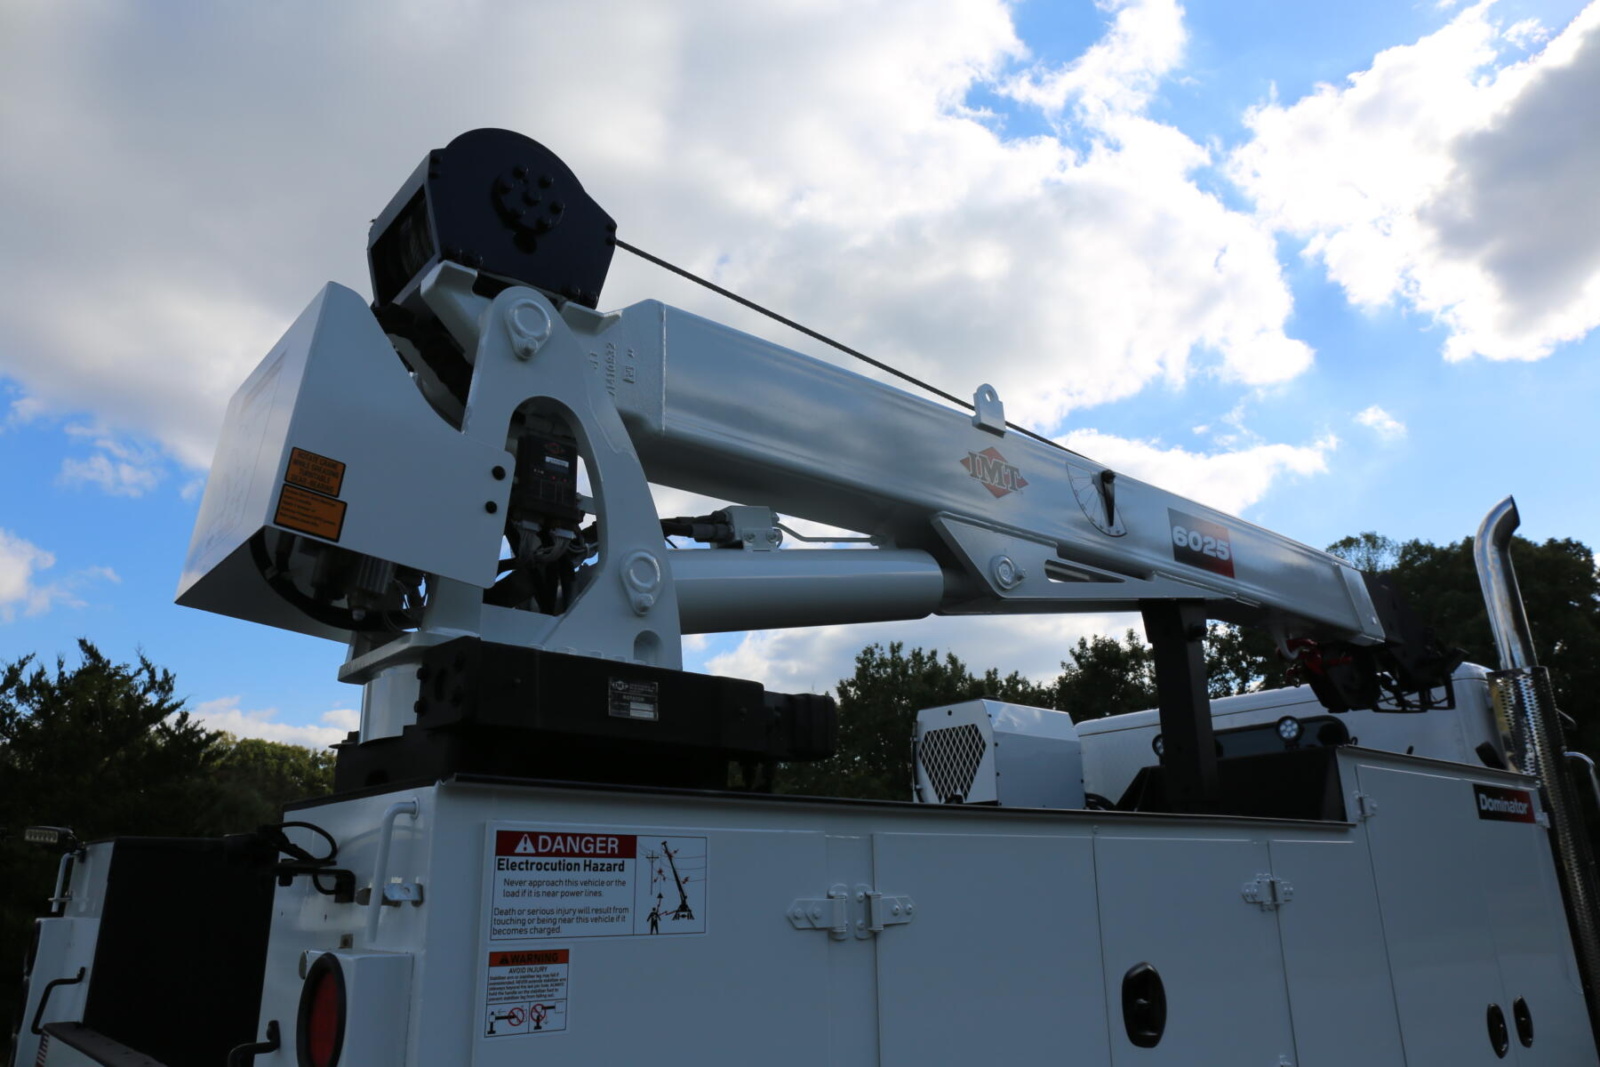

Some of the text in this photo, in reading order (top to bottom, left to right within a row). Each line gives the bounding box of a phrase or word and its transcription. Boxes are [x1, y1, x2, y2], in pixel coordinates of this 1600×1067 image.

[968, 450, 1020, 492] IMT
[1173, 525, 1230, 561] 6025
[1479, 793, 1528, 815] Dominator
[537, 835, 619, 854] DANGER
[497, 858, 625, 872] Electrocution Hazard
[503, 879, 527, 887] Never
[528, 879, 563, 889] approach
[565, 879, 579, 887] this
[580, 879, 605, 887] vehicle
[615, 879, 626, 887] the
[503, 889, 520, 898] load
[521, 889, 527, 897] if
[533, 889, 541, 897] is
[560, 890, 584, 899] power
[493, 907, 516, 916] Death
[527, 907, 555, 915] serious
[556, 907, 578, 916] injury
[578, 906, 590, 915] will
[591, 906, 612, 914] result
[612, 906, 629, 914] from
[493, 917, 526, 927] touching
[536, 916, 557, 926] being
[575, 916, 590, 924] this
[590, 915, 615, 923] vehicle
[492, 927, 528, 936] becomes
[511, 952, 558, 963] WARNING
